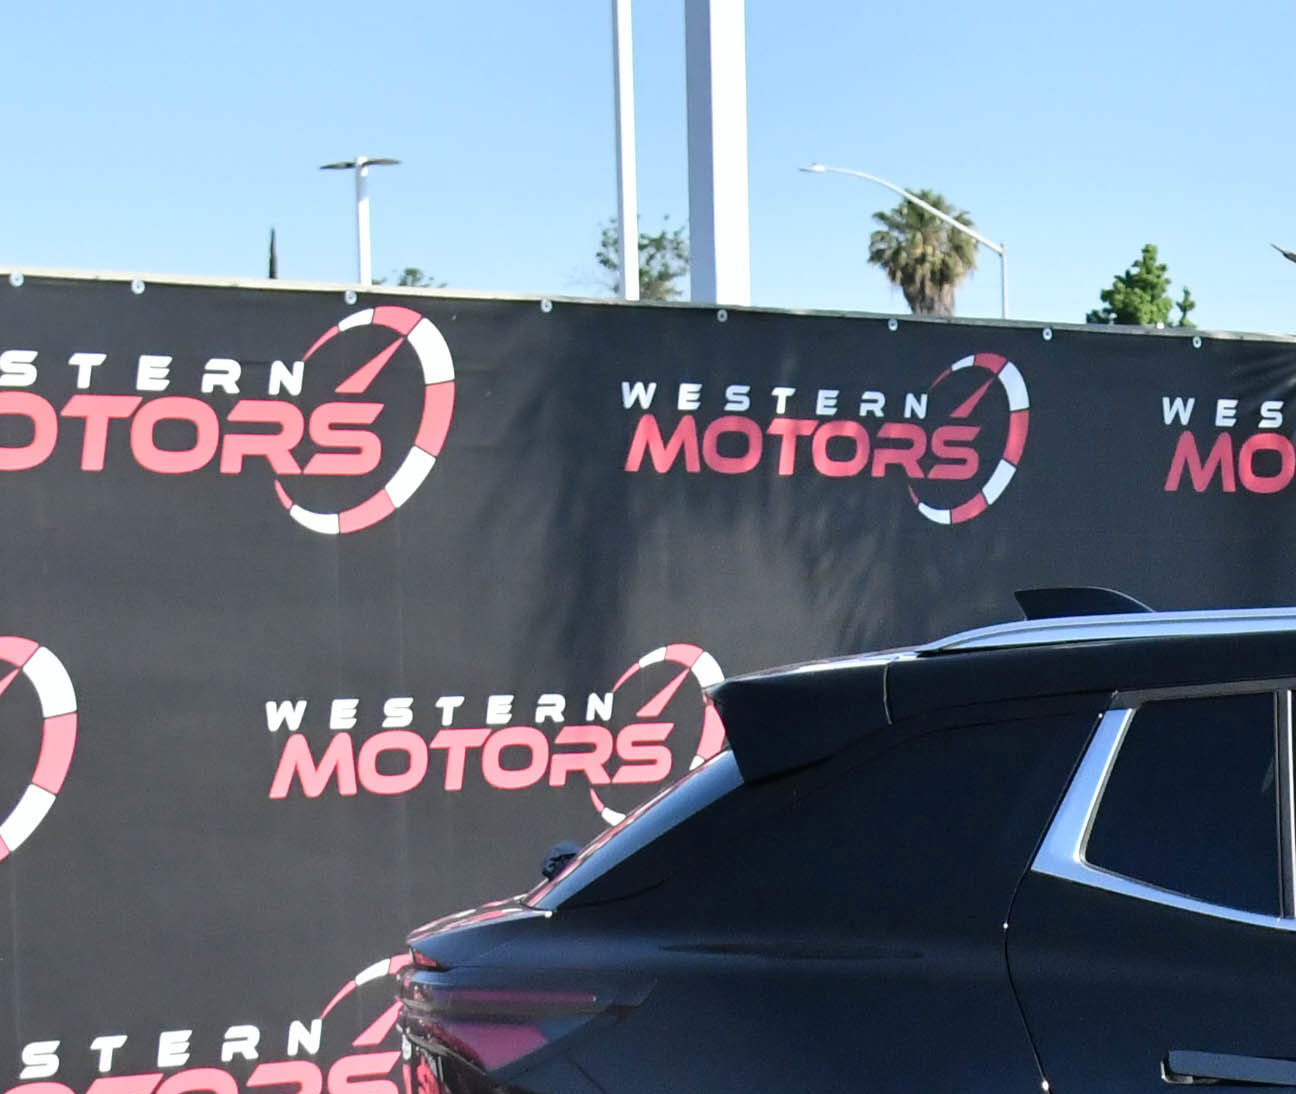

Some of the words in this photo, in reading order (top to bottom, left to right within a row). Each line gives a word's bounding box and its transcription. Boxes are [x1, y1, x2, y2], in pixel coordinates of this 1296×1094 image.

[621, 381, 928, 419] WESTERN
[624, 413, 981, 481] MOTORS
[264, 689, 616, 733] WESTERN
[268, 721, 675, 801] MOTORS
[18, 1018, 323, 1081] STERN
